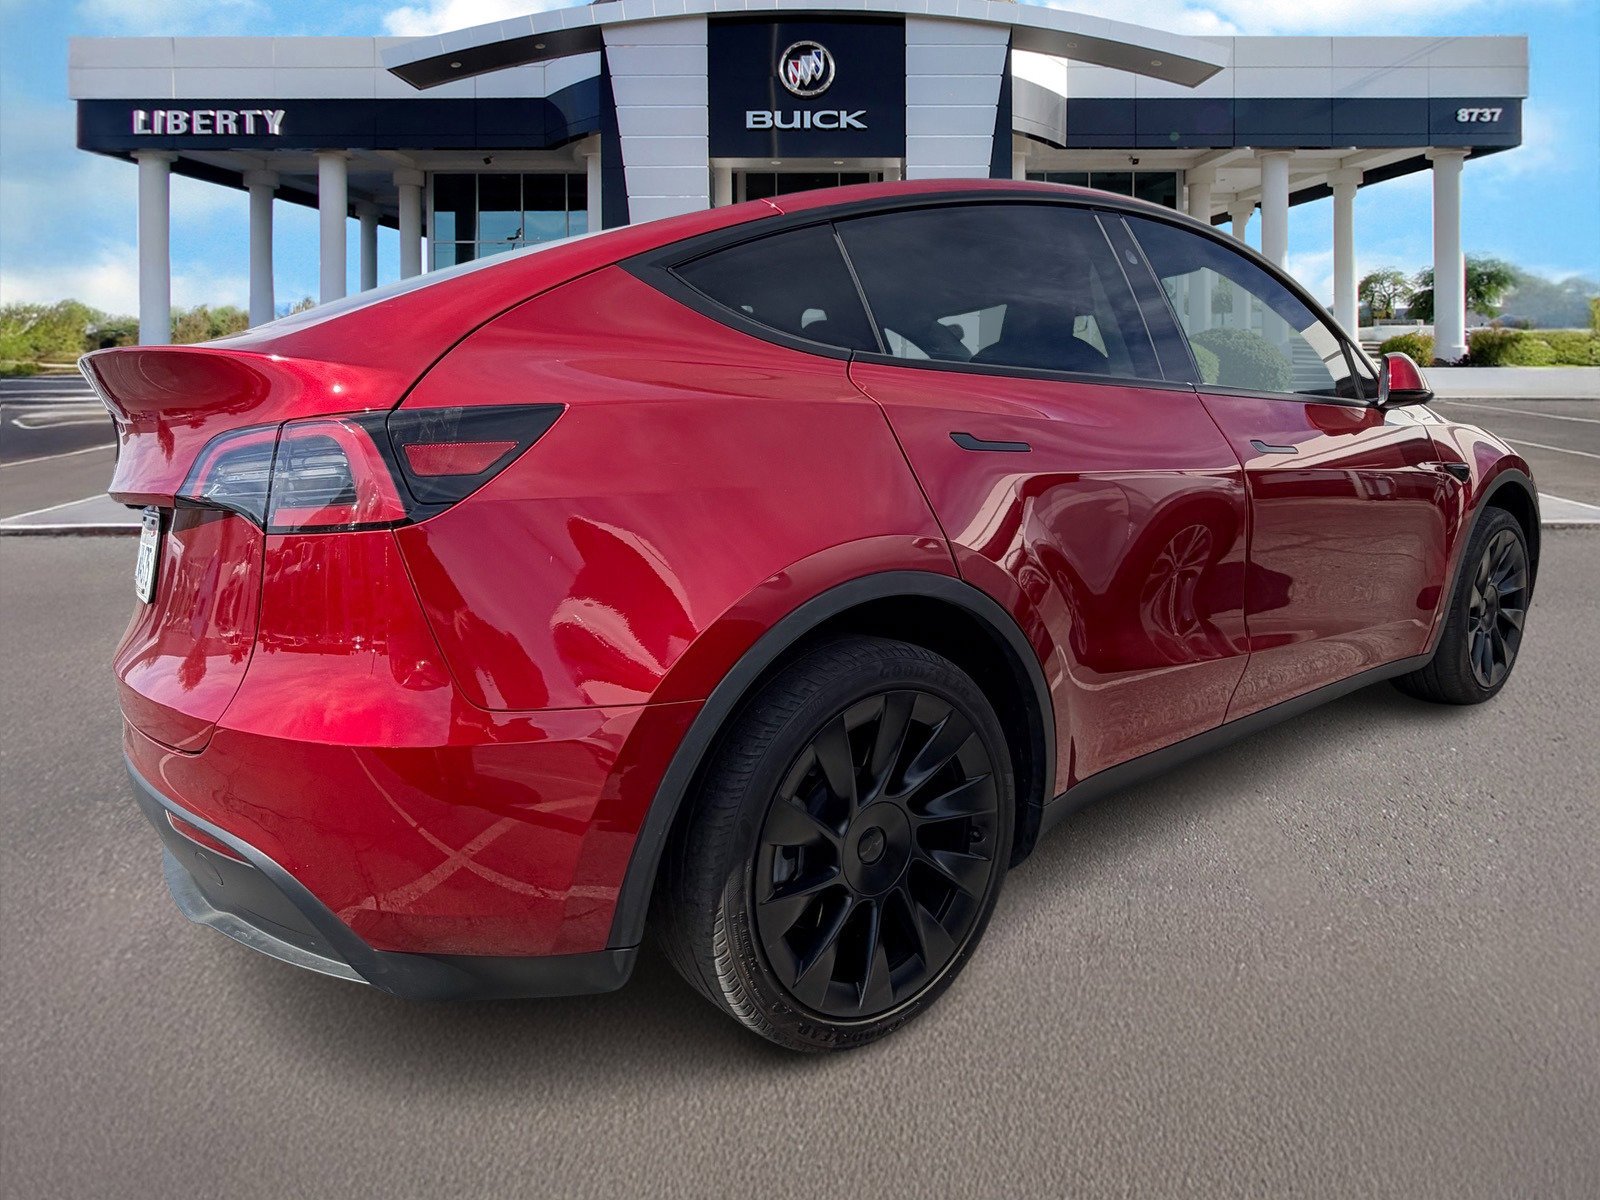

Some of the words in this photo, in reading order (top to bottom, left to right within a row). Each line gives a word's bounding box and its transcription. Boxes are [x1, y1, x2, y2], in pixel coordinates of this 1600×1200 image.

[132, 110, 285, 135] LIBERTY
[746, 110, 868, 129] BUICK
[1457, 108, 1502, 122] 8737
